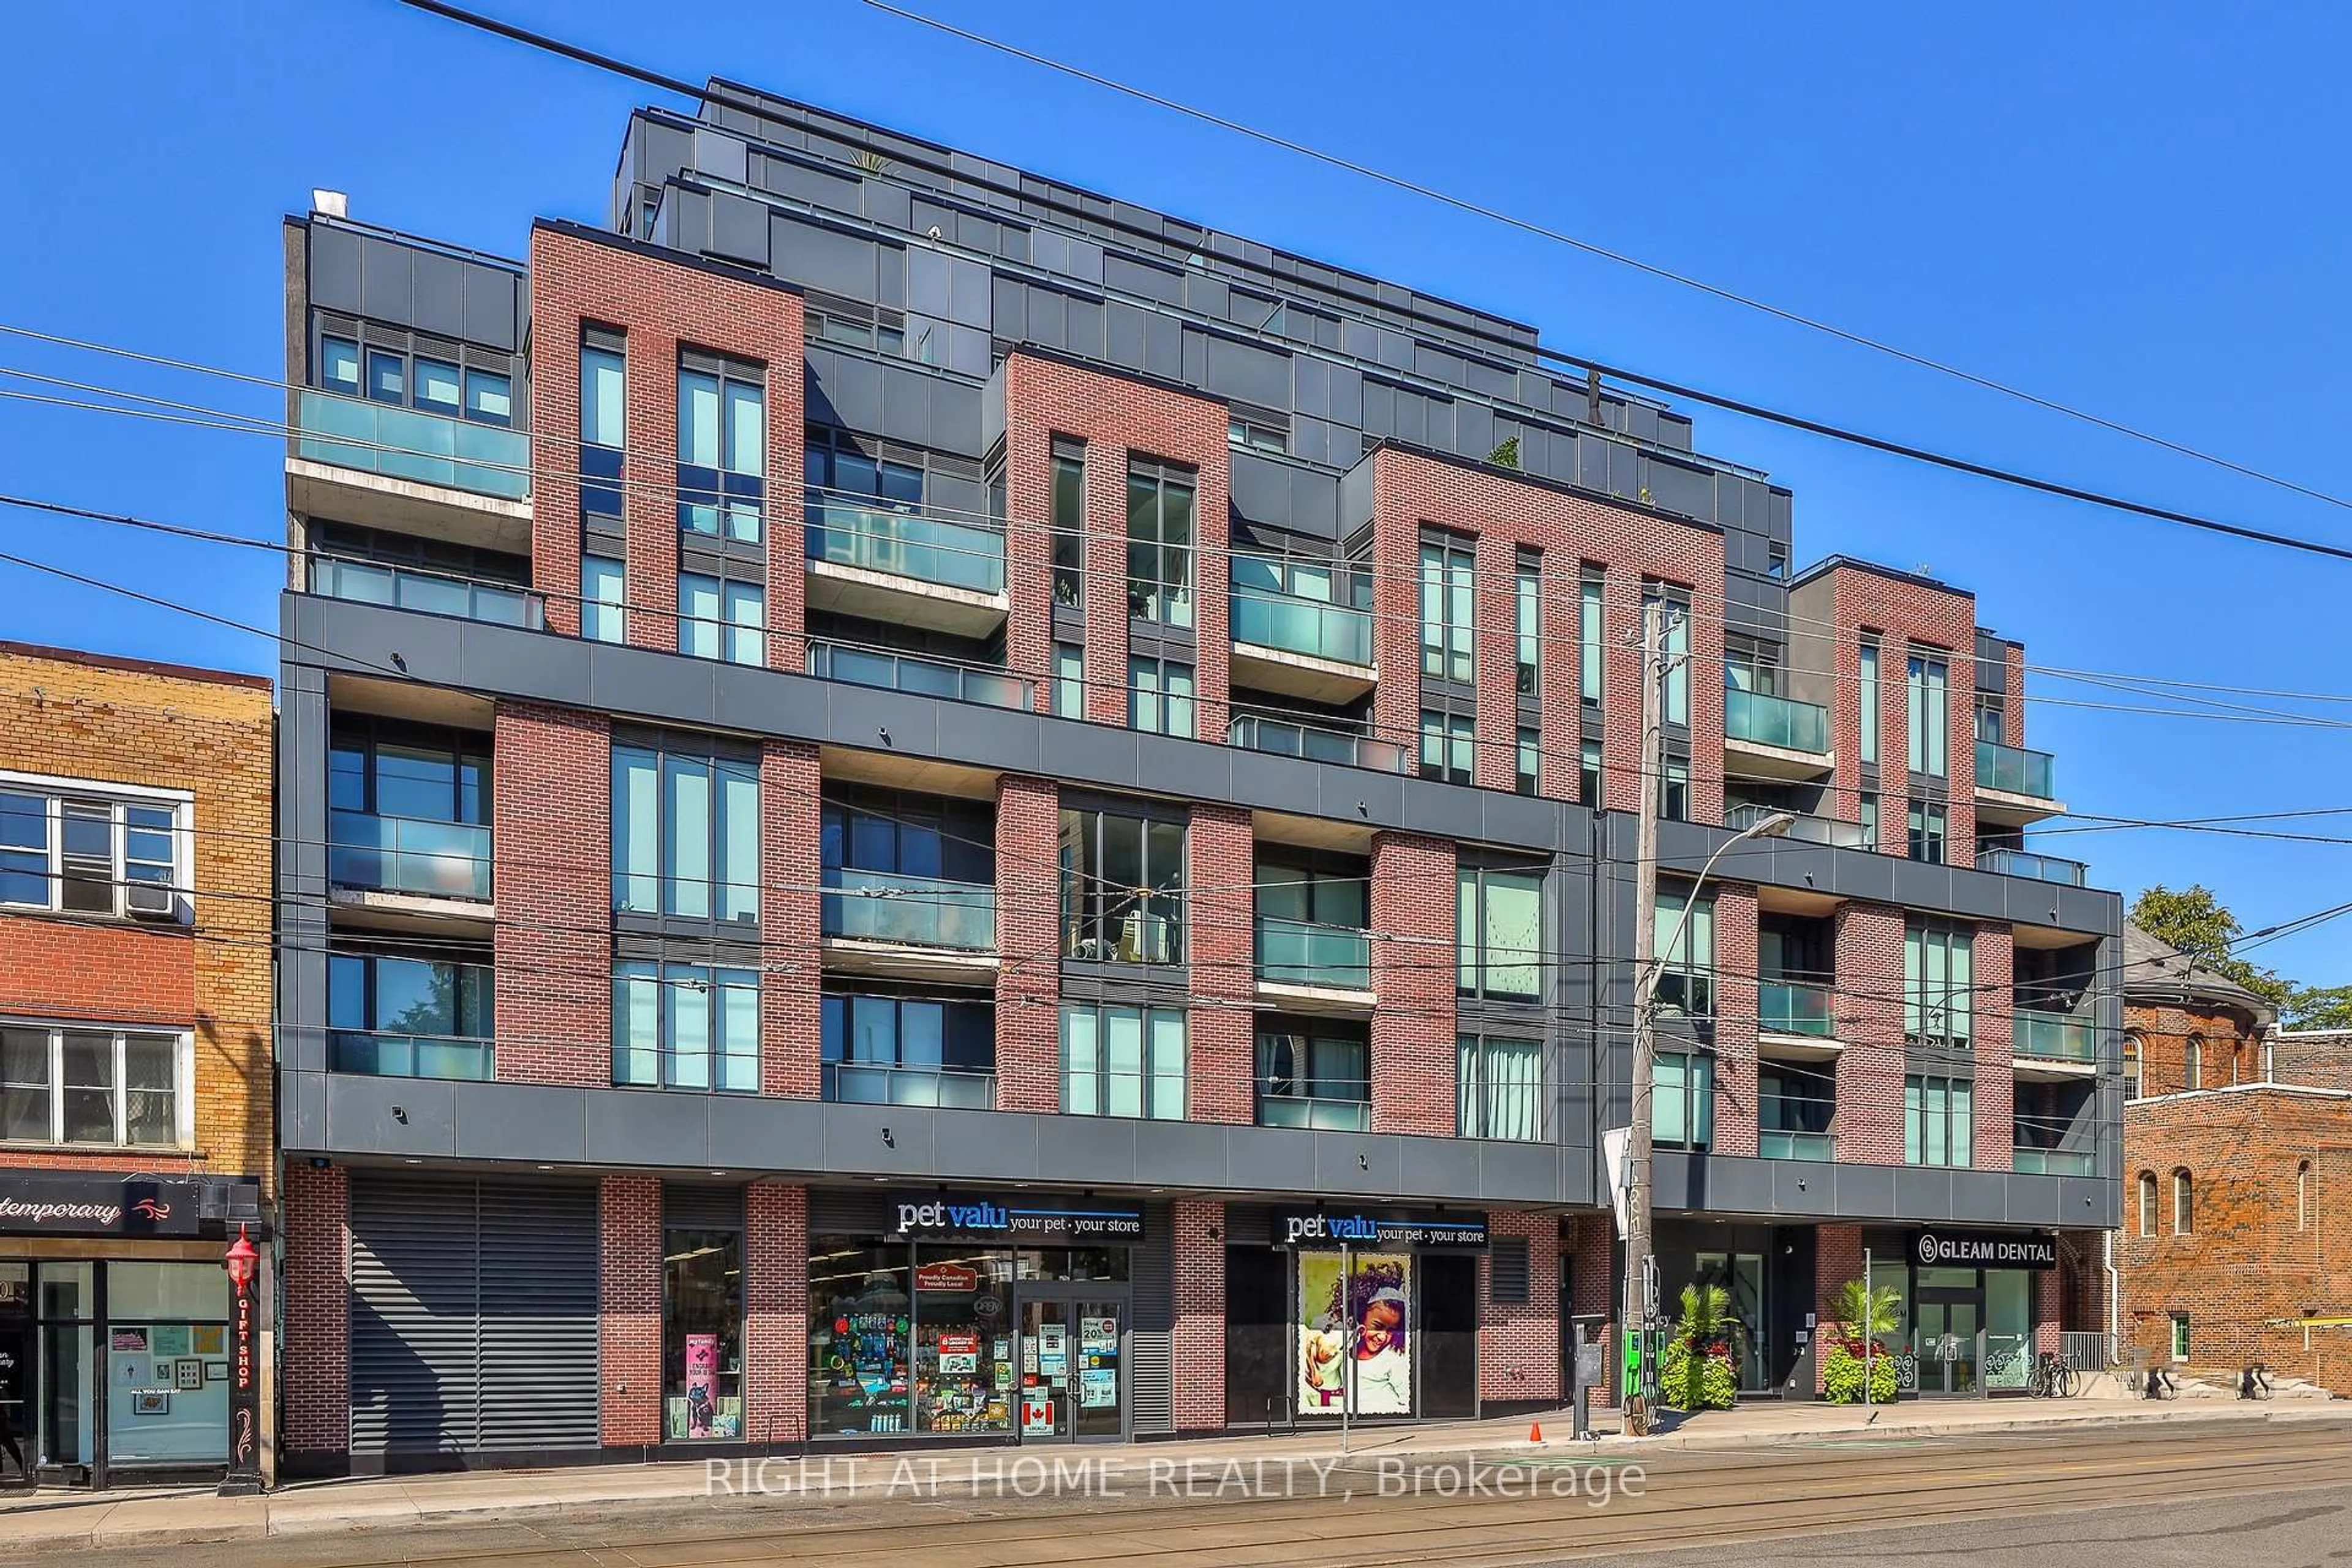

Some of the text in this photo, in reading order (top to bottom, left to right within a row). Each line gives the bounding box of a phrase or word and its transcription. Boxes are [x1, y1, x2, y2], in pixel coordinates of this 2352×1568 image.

[897, 1201, 1139, 1234] pet valu your pet your store
[1286, 1213, 1484, 1244] pet valu your pet your store
[1939, 1240, 2054, 1261] GLEAM DENTAL
[238, 1299, 248, 1388] GIFT SHOP
